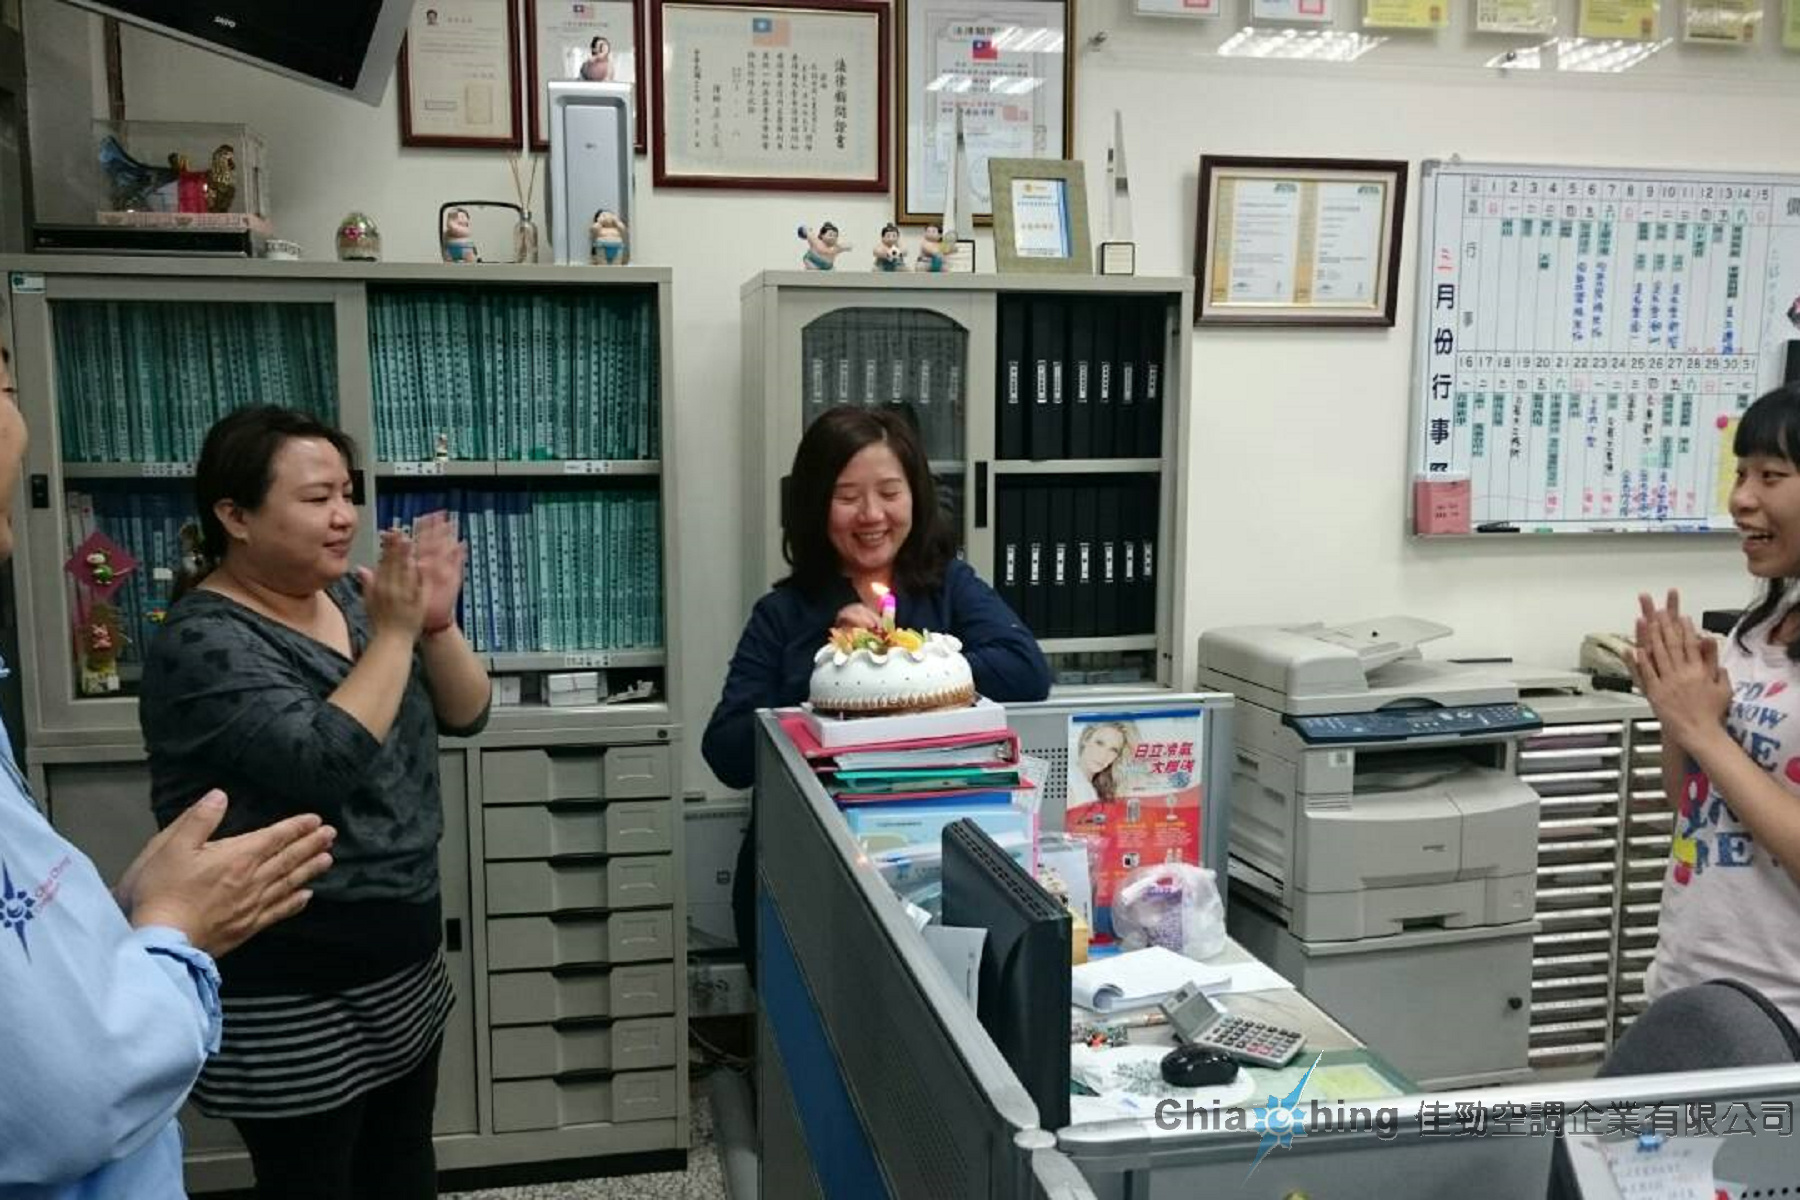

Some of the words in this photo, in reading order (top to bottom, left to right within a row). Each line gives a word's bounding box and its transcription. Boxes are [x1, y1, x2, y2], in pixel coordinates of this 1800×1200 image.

[1510, 182, 1518, 192] 2
[1529, 182, 1537, 193] 3
[1549, 183, 1557, 193] 4
[1568, 183, 1577, 194] 5
[1588, 184, 1596, 195] 6
[1608, 185, 1615, 195] 7
[1627, 185, 1634, 196] 8
[1646, 186, 1654, 197] 9
[1662, 187, 1676, 198] 10
[1682, 187, 1694, 198] 11
[1701, 188, 1713, 198] 12
[1720, 188, 1732, 198] 13
[1737, 188, 1751, 198] 14
[1756, 188, 1768, 199] 15
[1459, 356, 1473, 368] 16
[1479, 357, 1492, 367] 17
[1497, 357, 1511, 368] 18
[1517, 357, 1531, 368] 19
[1536, 357, 1550, 368] 20
[1556, 357, 1569, 368] 21
[1574, 357, 1589, 368] 22
[1592, 358, 1607, 368] 23
[1612, 358, 1625, 368] 24
[1631, 358, 1646, 369] 25
[1648, 358, 1663, 369] 26
[1667, 358, 1683, 369] 27
[1686, 358, 1700, 369] 28
[1705, 358, 1719, 369] 29
[1722, 358, 1738, 369] 30
[1742, 358, 1756, 370] 31
[1728, 702, 1788, 729] NOW
